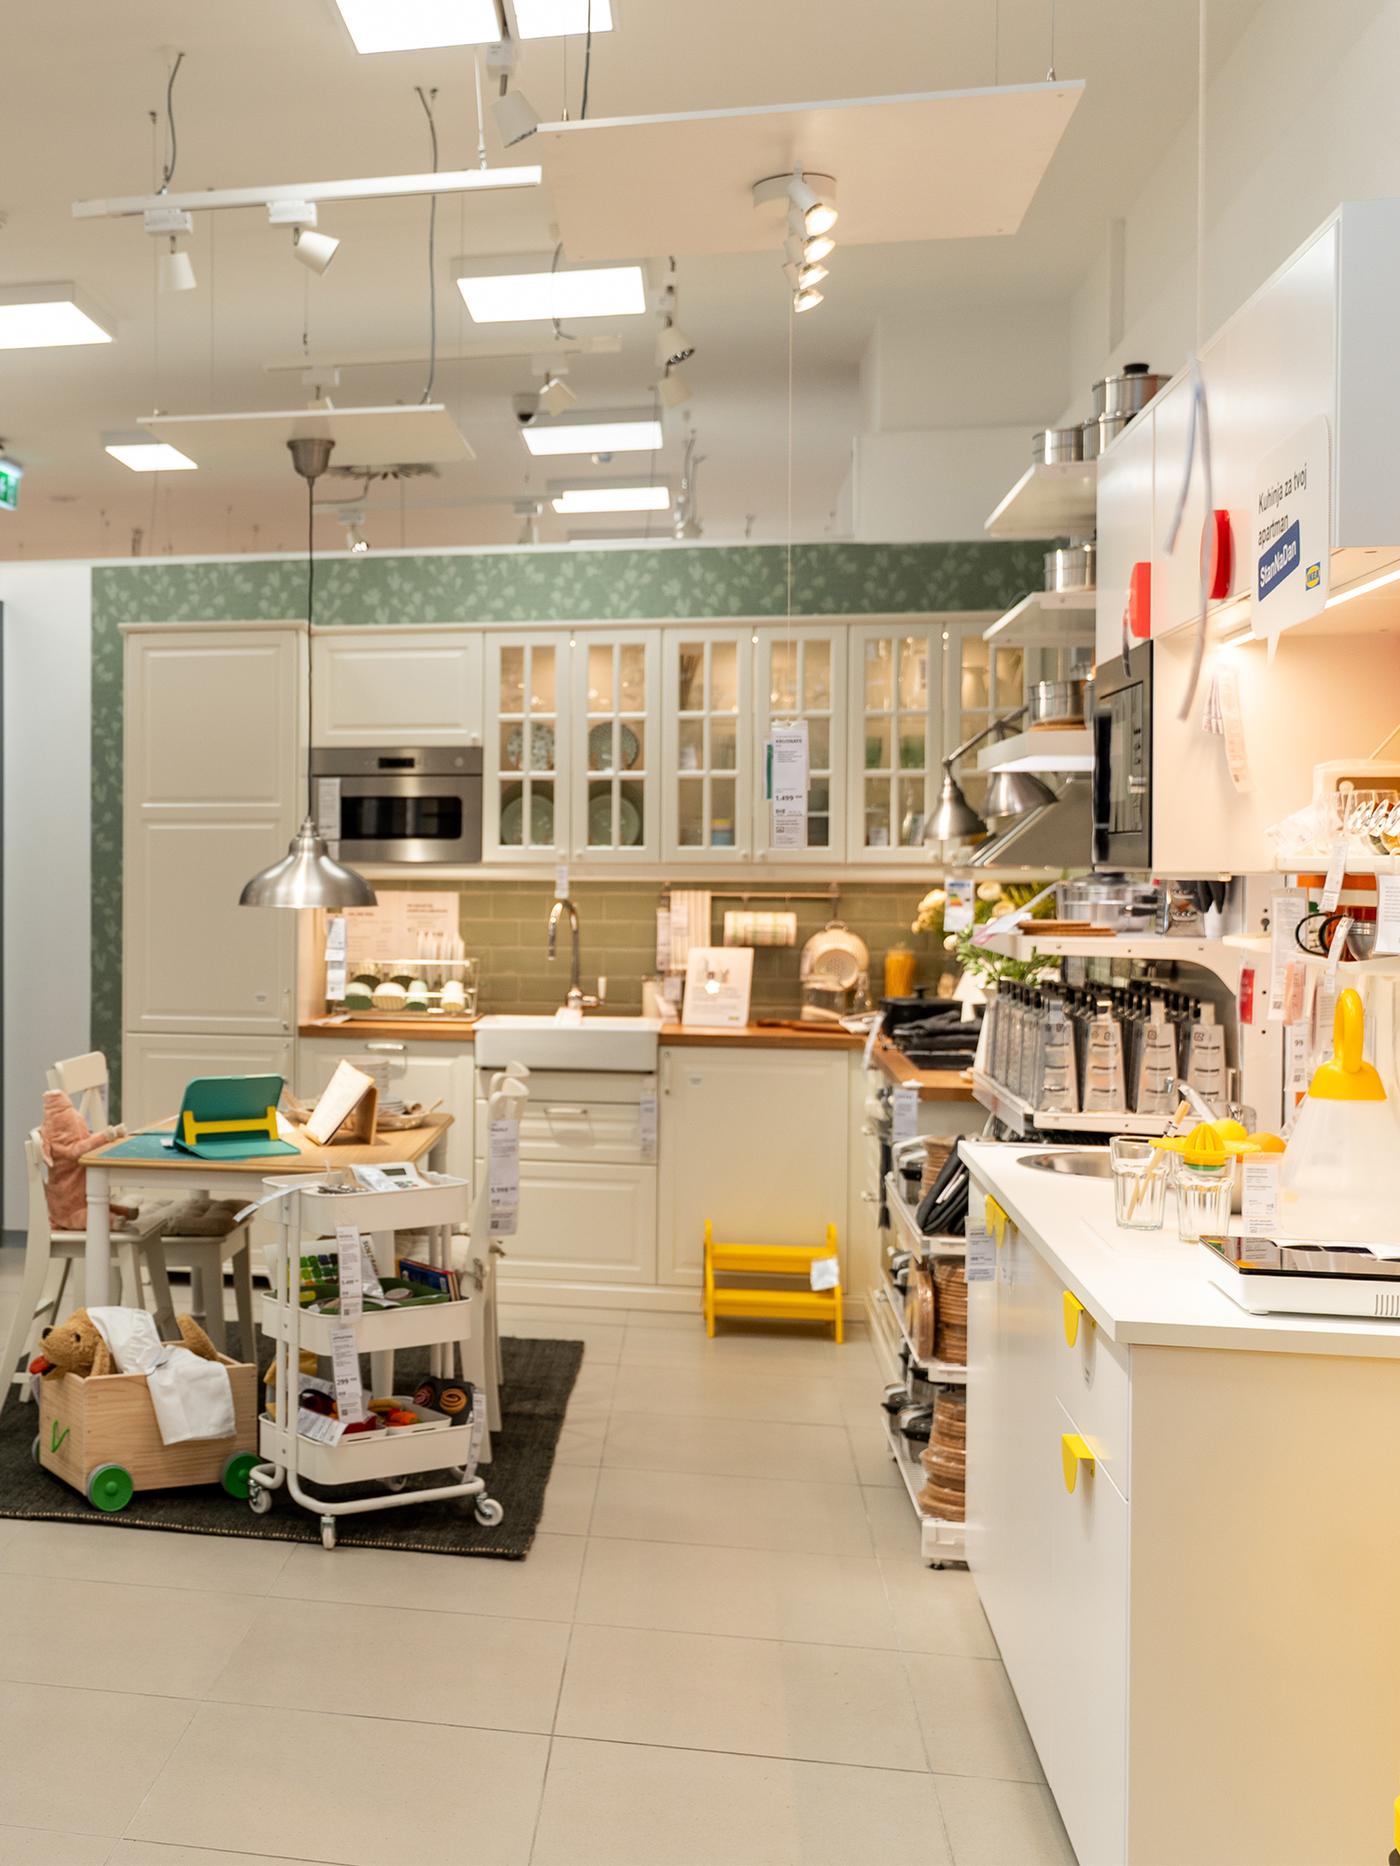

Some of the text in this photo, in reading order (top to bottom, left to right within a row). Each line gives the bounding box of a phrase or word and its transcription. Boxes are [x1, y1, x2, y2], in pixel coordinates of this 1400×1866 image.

[1258, 462, 1306, 514] Kuhinja za tvoj
[1258, 514, 1288, 549] apartman
[1260, 540, 1297, 588] StanNaDan
[1307, 568, 1319, 583] IKEA
